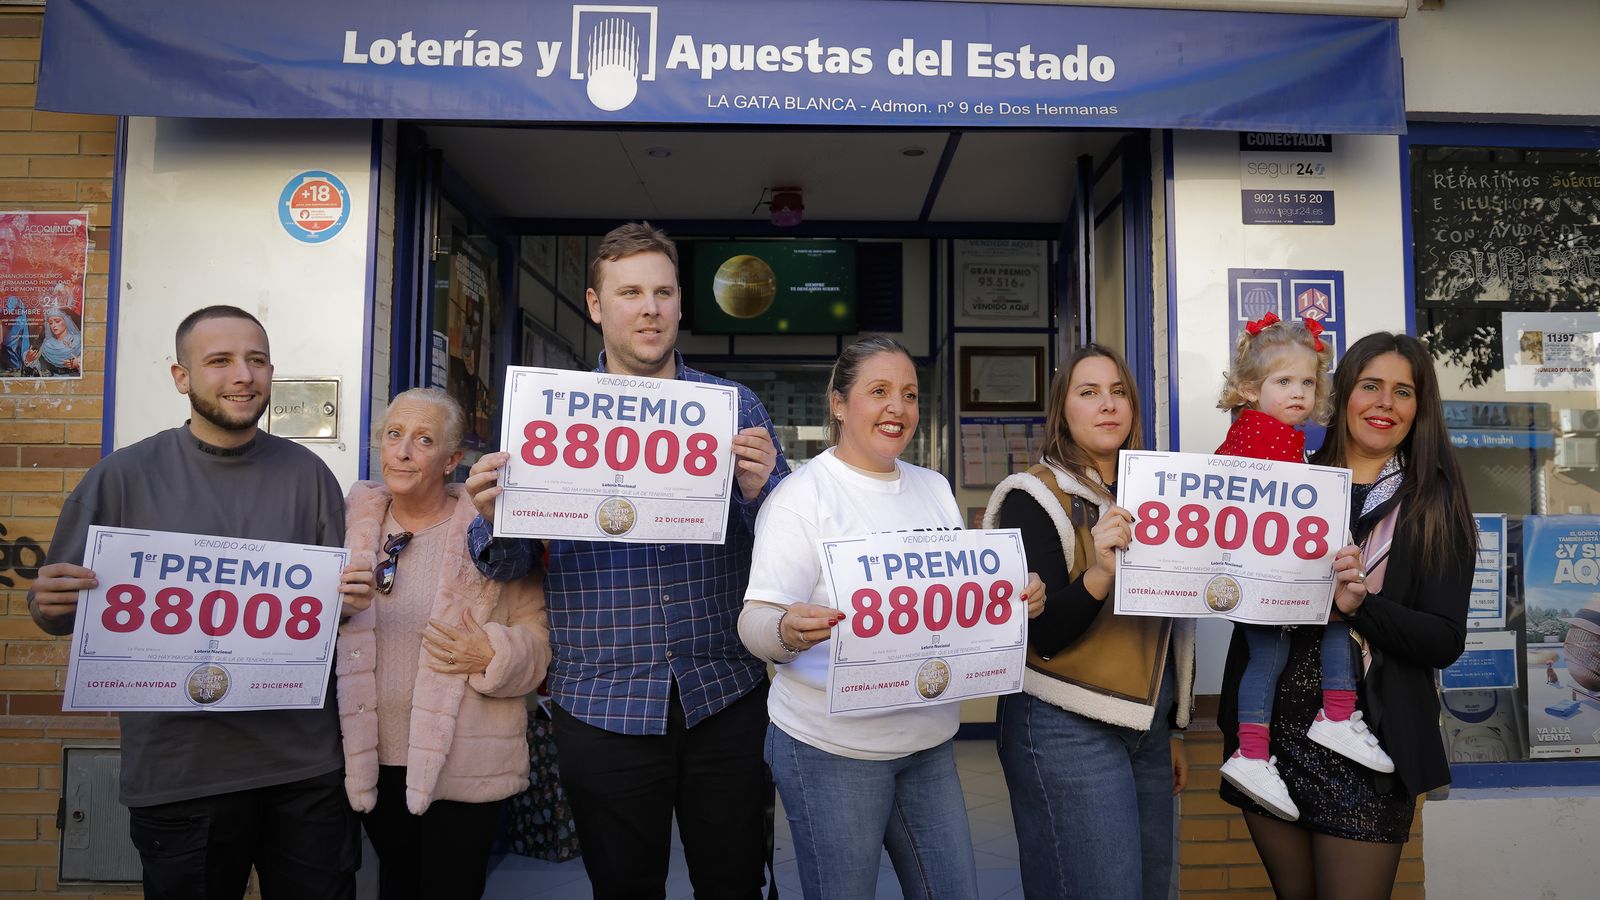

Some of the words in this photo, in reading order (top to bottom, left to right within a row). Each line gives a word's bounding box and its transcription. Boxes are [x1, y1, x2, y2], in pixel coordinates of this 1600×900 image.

[342, 29, 523, 67] Loterías
[535, 40, 563, 77] y
[665, 34, 873, 80] Apuestas
[887, 38, 953, 77] del
[967, 43, 1116, 82] Estado
[707, 95, 729, 108] LA
[734, 95, 780, 109] GATA
[785, 96, 856, 111] BLANCA
[870, 99, 932, 113] Admon.
[959, 101, 969, 114] 9
[974, 102, 993, 114] de
[1000, 103, 1031, 115] Dos
[1036, 103, 1118, 115] Hermanas
[1247, 133, 1326, 147] CONECTADA
[1247, 162, 1314, 178] segur24
[301, 185, 330, 202] +18
[1254, 194, 1274, 203] 902
[1278, 194, 1290, 203] 15
[1294, 194, 1307, 203] 15
[1309, 194, 1323, 203] 20
[1433, 197, 1443, 210] E
[1437, 229, 1474, 243] CON
[1489, 224, 1546, 239] AYUDA
[1547, 334, 1575, 343] 11397
[596, 377, 637, 388] VENDIDO
[638, 381, 662, 390] AQUÍ
[568, 391, 705, 427] PREMIO
[520, 420, 718, 477] 88008
[1207, 458, 1247, 469] VENDIDO
[1249, 461, 1273, 471] AQUÍ
[1180, 472, 1318, 510] PREMIO
[902, 535, 937, 544] VENDIDO
[938, 533, 958, 543] AQUÍ
[1134, 501, 1329, 560] 88008
[193, 538, 238, 551] VENDIDO
[239, 543, 266, 552] AQUÍ
[1555, 544, 1579, 558] ¿Y
[159, 554, 312, 590] PREMIO
[883, 549, 1001, 580] PREMIO
[1553, 558, 1600, 585] AQ
[101, 583, 323, 640] 88008
[851, 579, 1014, 639] 88008
[975, 668, 1007, 678] DICIEMBRE
[1537, 734, 1572, 742] VENTA
